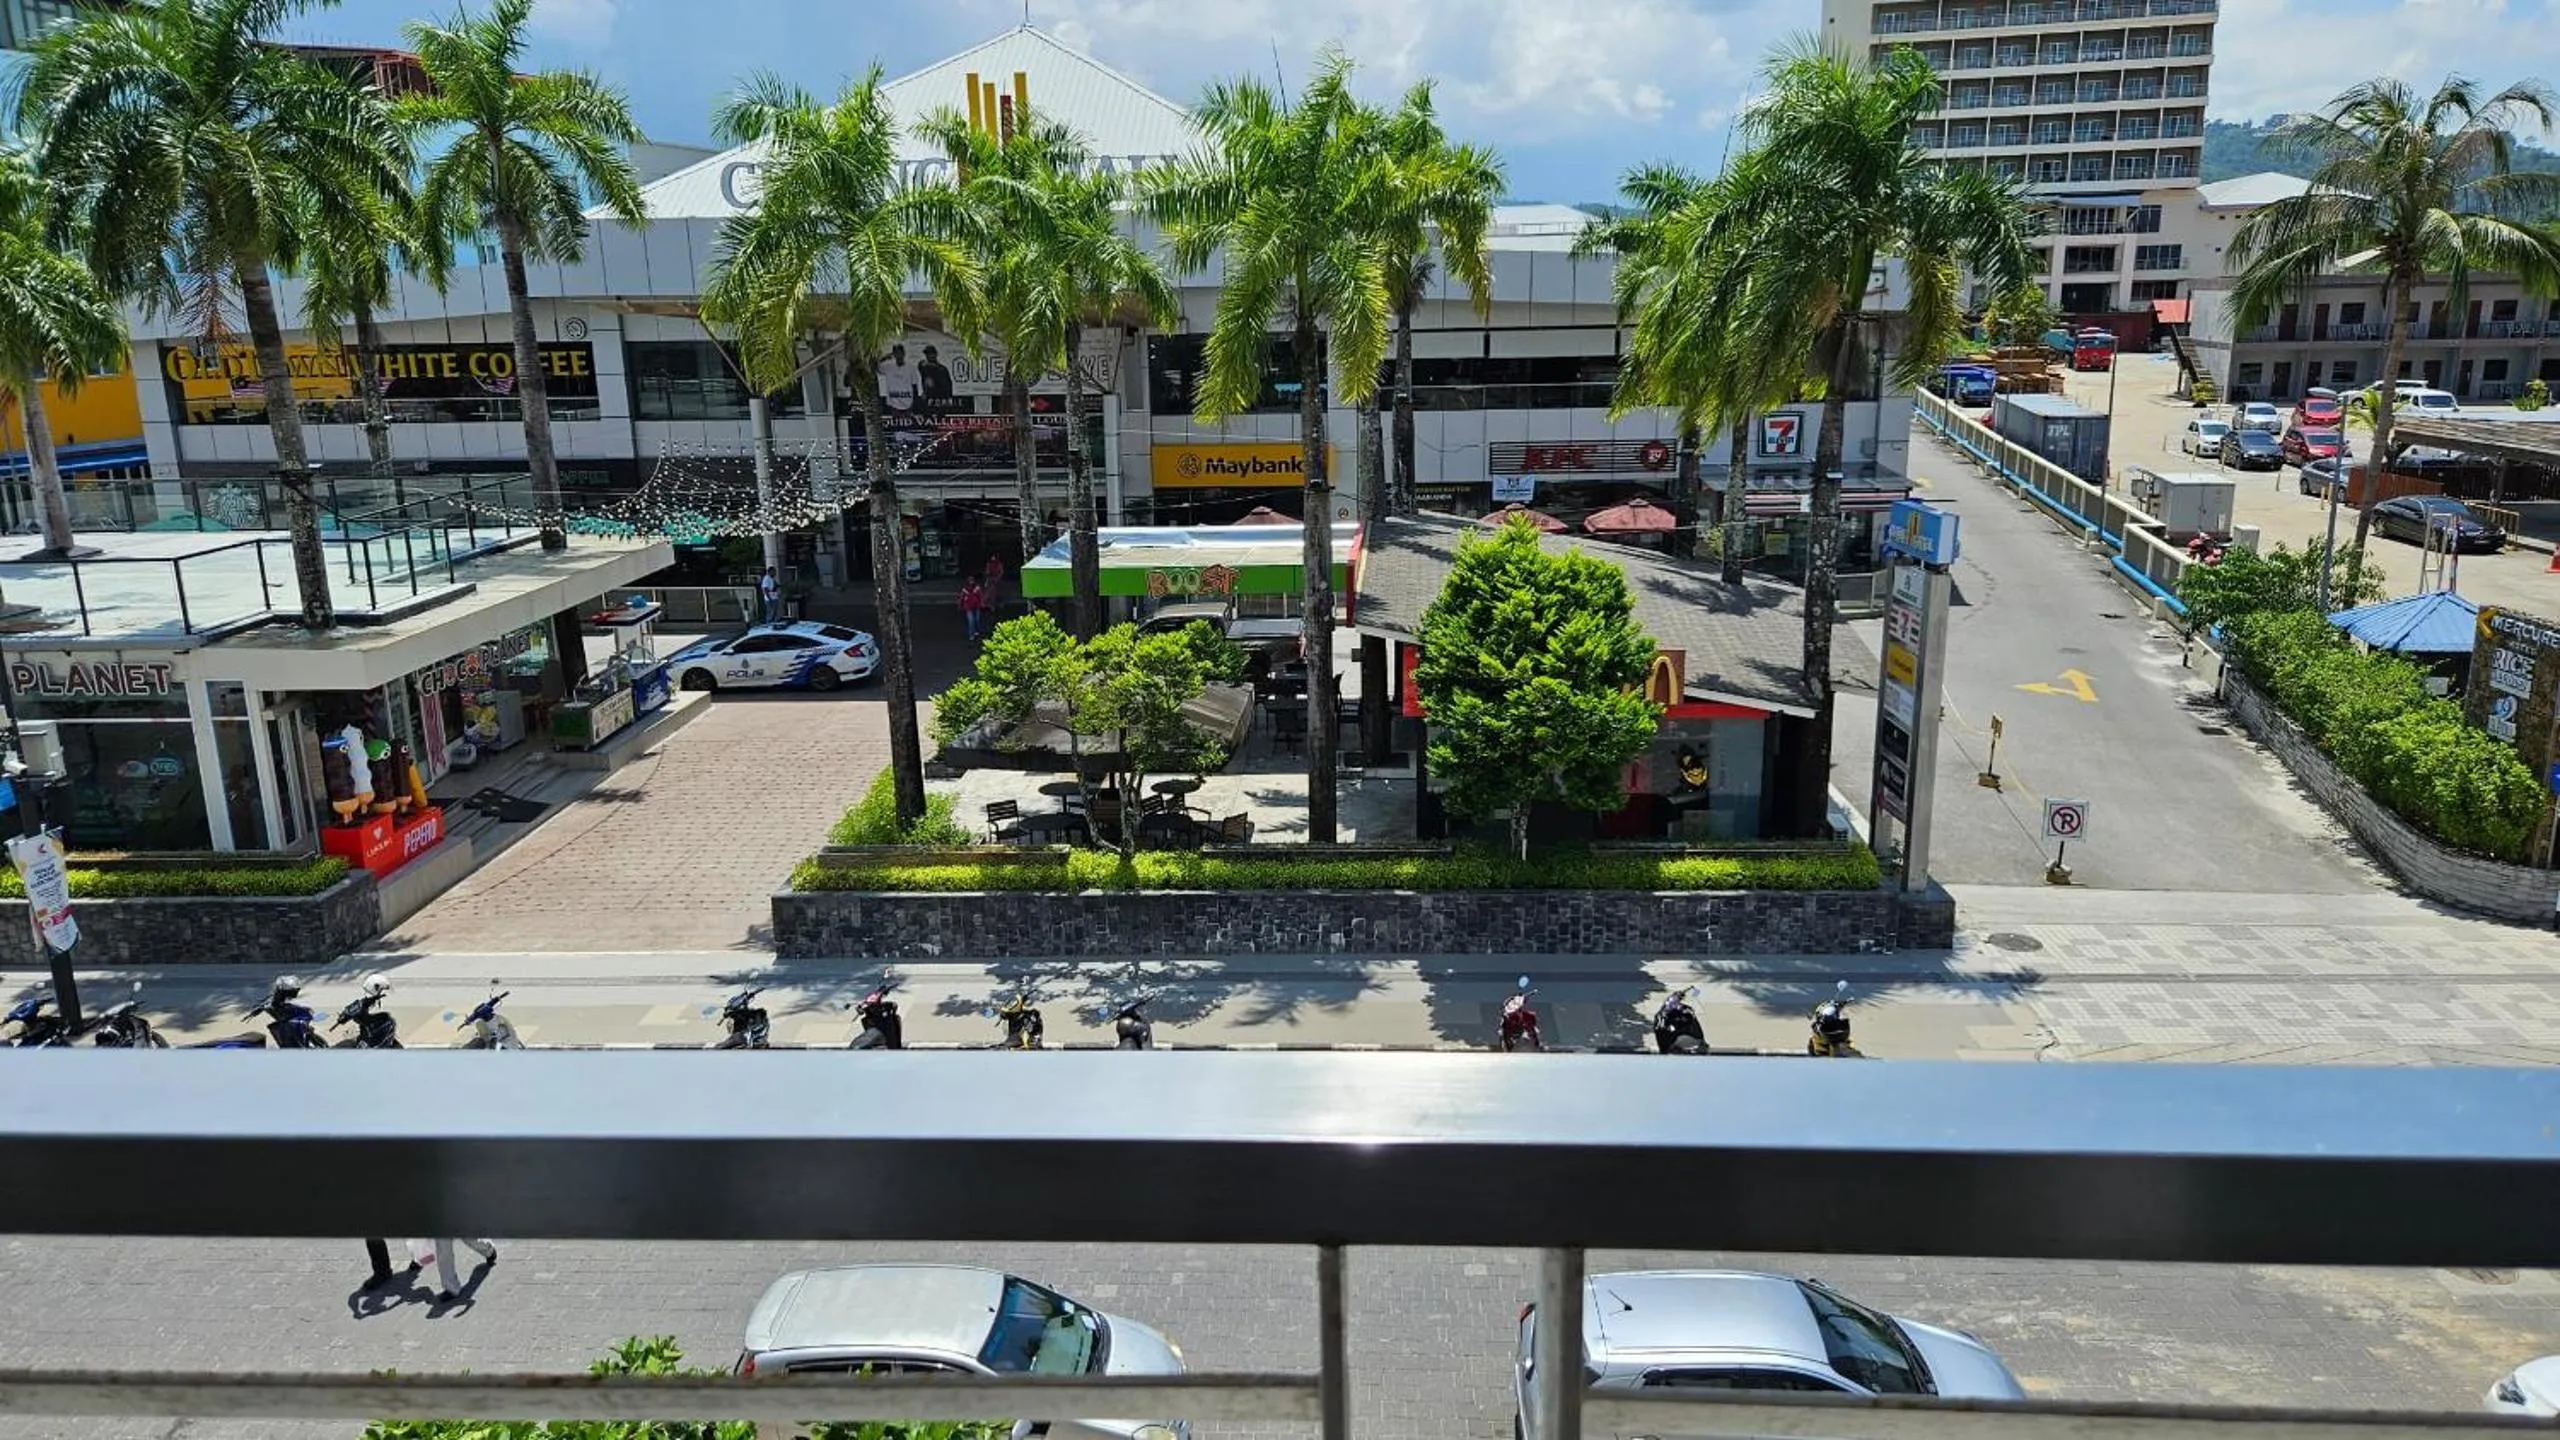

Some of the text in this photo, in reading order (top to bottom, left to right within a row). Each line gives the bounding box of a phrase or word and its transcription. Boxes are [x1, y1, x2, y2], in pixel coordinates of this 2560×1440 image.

[1206, 456, 1303, 477] Maybank
[1521, 445, 1599, 469] KFC
[1147, 565, 1240, 598] BOOST
[2491, 615, 2560, 648] MERCURE
[11, 661, 172, 697] PLANET
[420, 651, 482, 697] CHOCO
[2492, 648, 2536, 678] RICE
